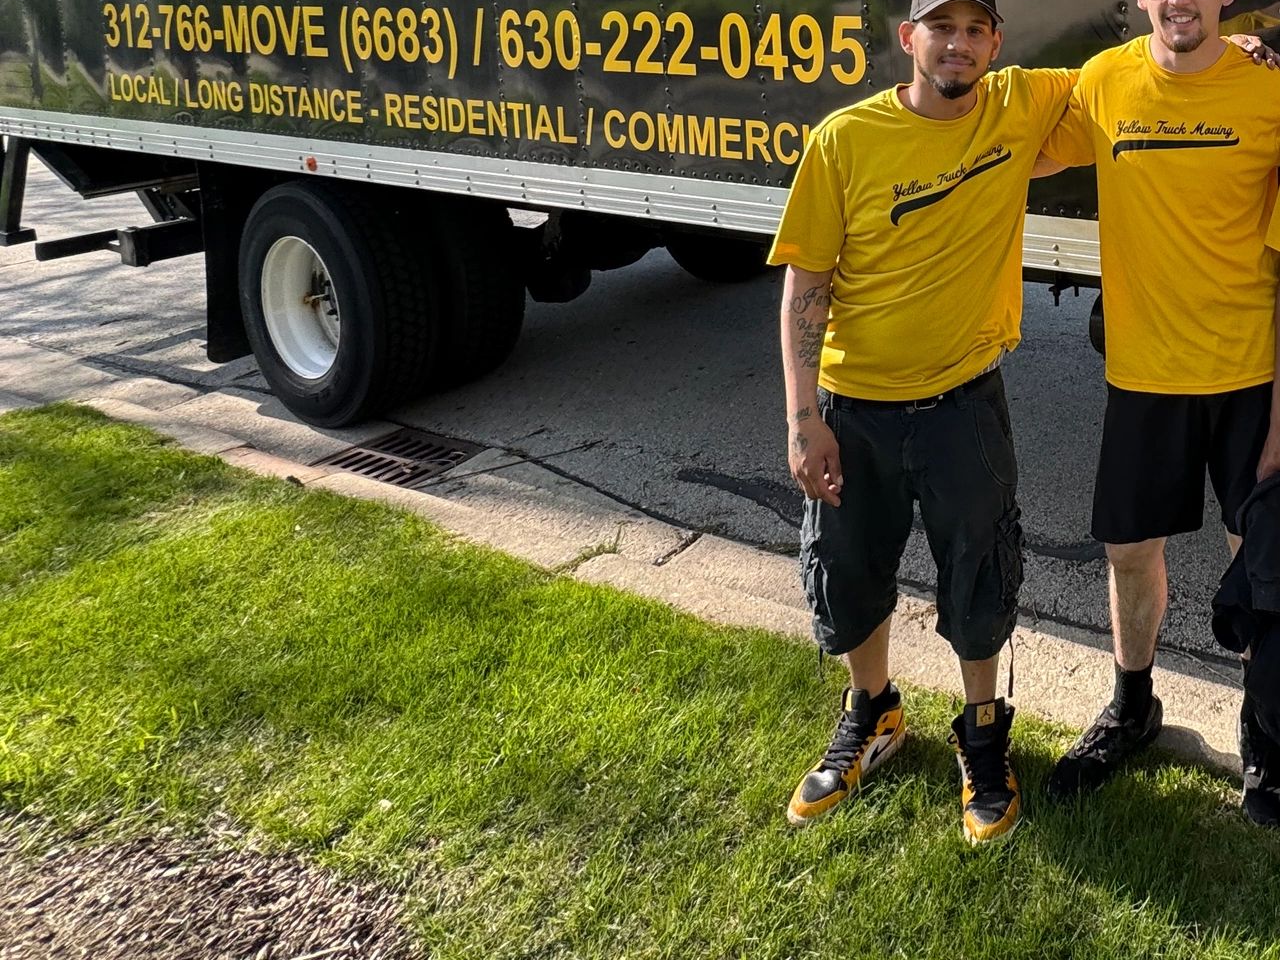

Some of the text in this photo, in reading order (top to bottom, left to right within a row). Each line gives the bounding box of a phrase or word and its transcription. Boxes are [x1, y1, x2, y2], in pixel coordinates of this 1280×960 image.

[103, 3, 867, 86] 312-766-MOVE (6683) / 630-222-0495
[184, 78, 244, 113] LONG
[249, 82, 363, 125] DISTANCE
[385, 94, 577, 145] RESIDENTIAL
[1116, 119, 1235, 139] Yellow Truck Moving
[892, 178, 934, 202] Yellow
[936, 162, 967, 187] Truck
